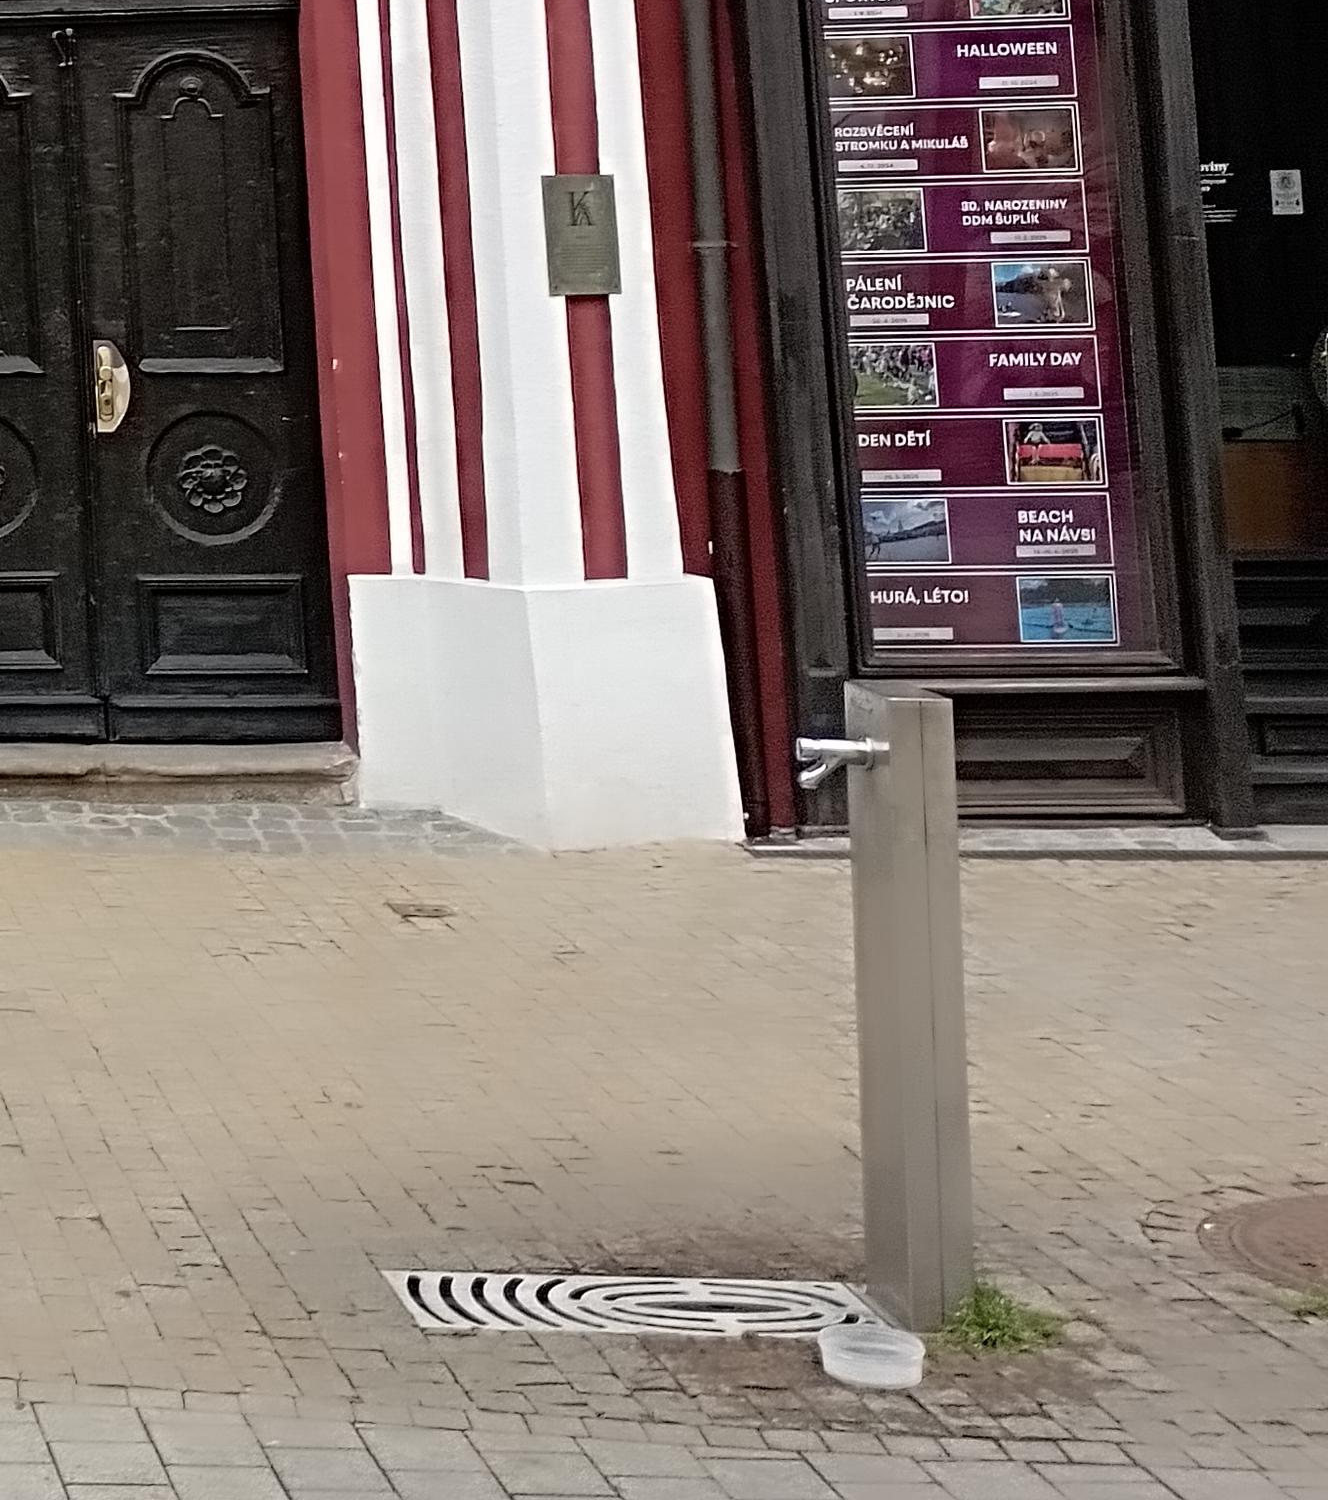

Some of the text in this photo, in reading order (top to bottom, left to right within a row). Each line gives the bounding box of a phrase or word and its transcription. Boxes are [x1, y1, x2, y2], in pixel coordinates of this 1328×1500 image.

[956, 42, 1058, 57] HALLOWEEN
[834, 122, 914, 137] ROZSVĚCENÍ
[835, 136, 969, 152] STROMKU A MIKULÁŠ
[984, 199, 1068, 211] NAROZENINY
[962, 211, 1039, 226] DDM ŠUPLÍK
[846, 274, 902, 291] PÁLENÍ
[847, 293, 955, 310] ČARODĚJNIC
[989, 352, 1082, 367] FAMILY DAY
[858, 429, 931, 447] DEN DĚTÍ
[1017, 510, 1073, 523] BEACH
[1019, 524, 1096, 542] NA NÁVSI
[870, 587, 921, 605] HURÁ,
